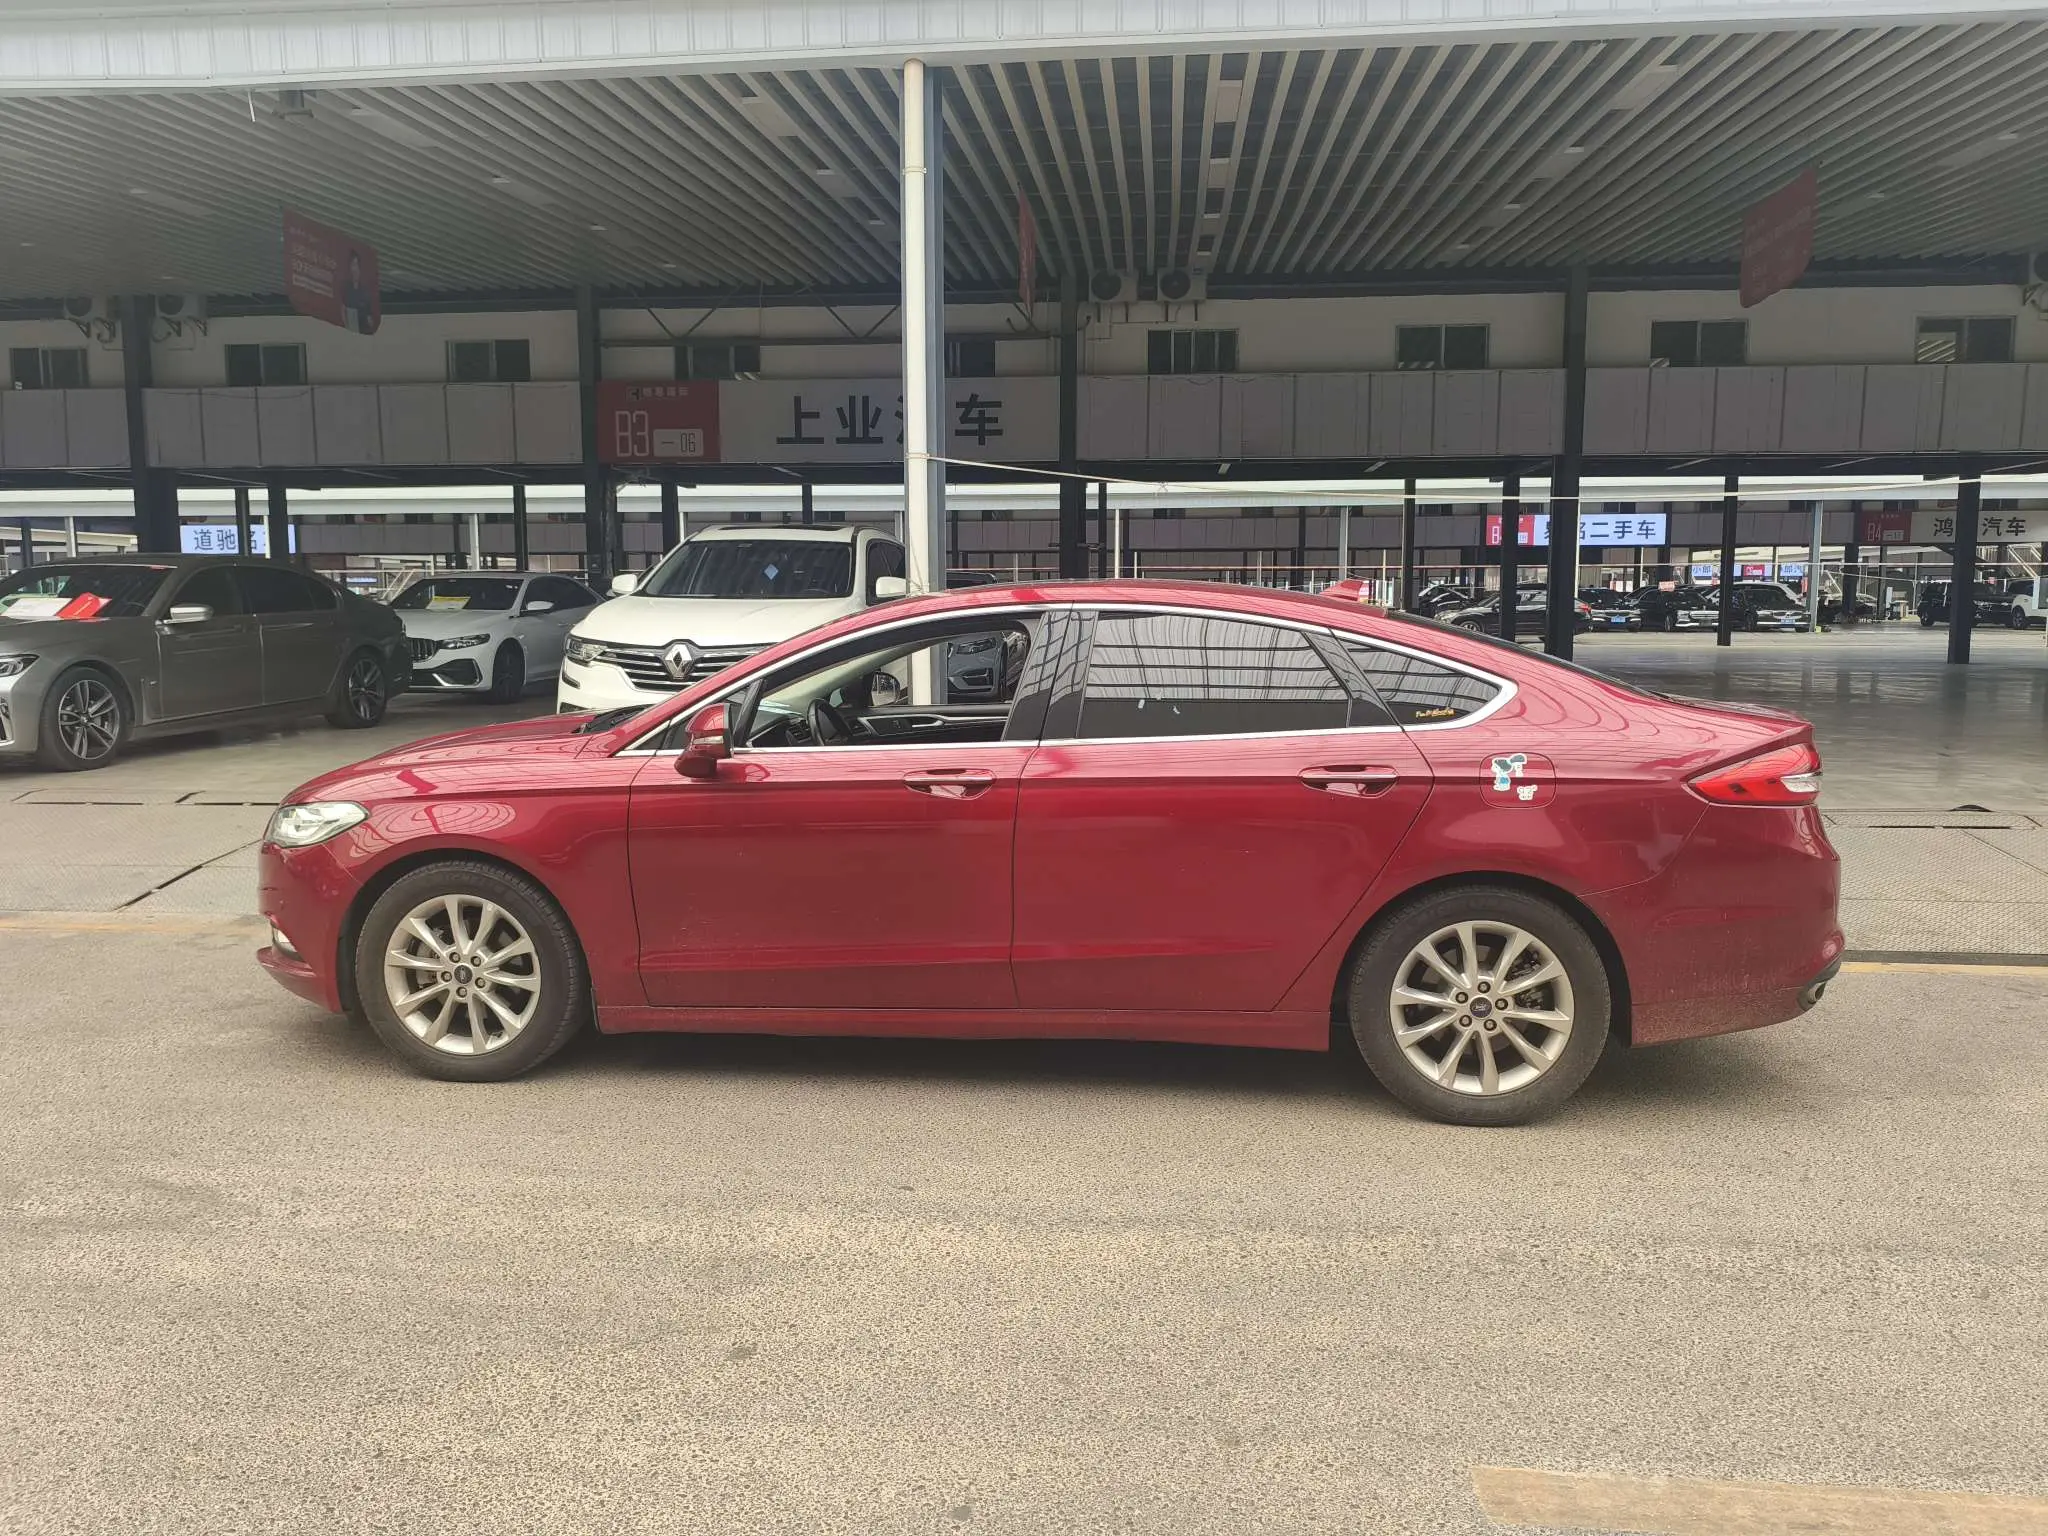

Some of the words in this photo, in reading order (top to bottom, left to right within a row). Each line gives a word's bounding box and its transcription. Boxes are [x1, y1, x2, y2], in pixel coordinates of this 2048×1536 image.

[616, 410, 650, 457] B3
[776, 393, 1003, 446] 上业车
[1933, 516, 2026, 537] 鸿汽车
